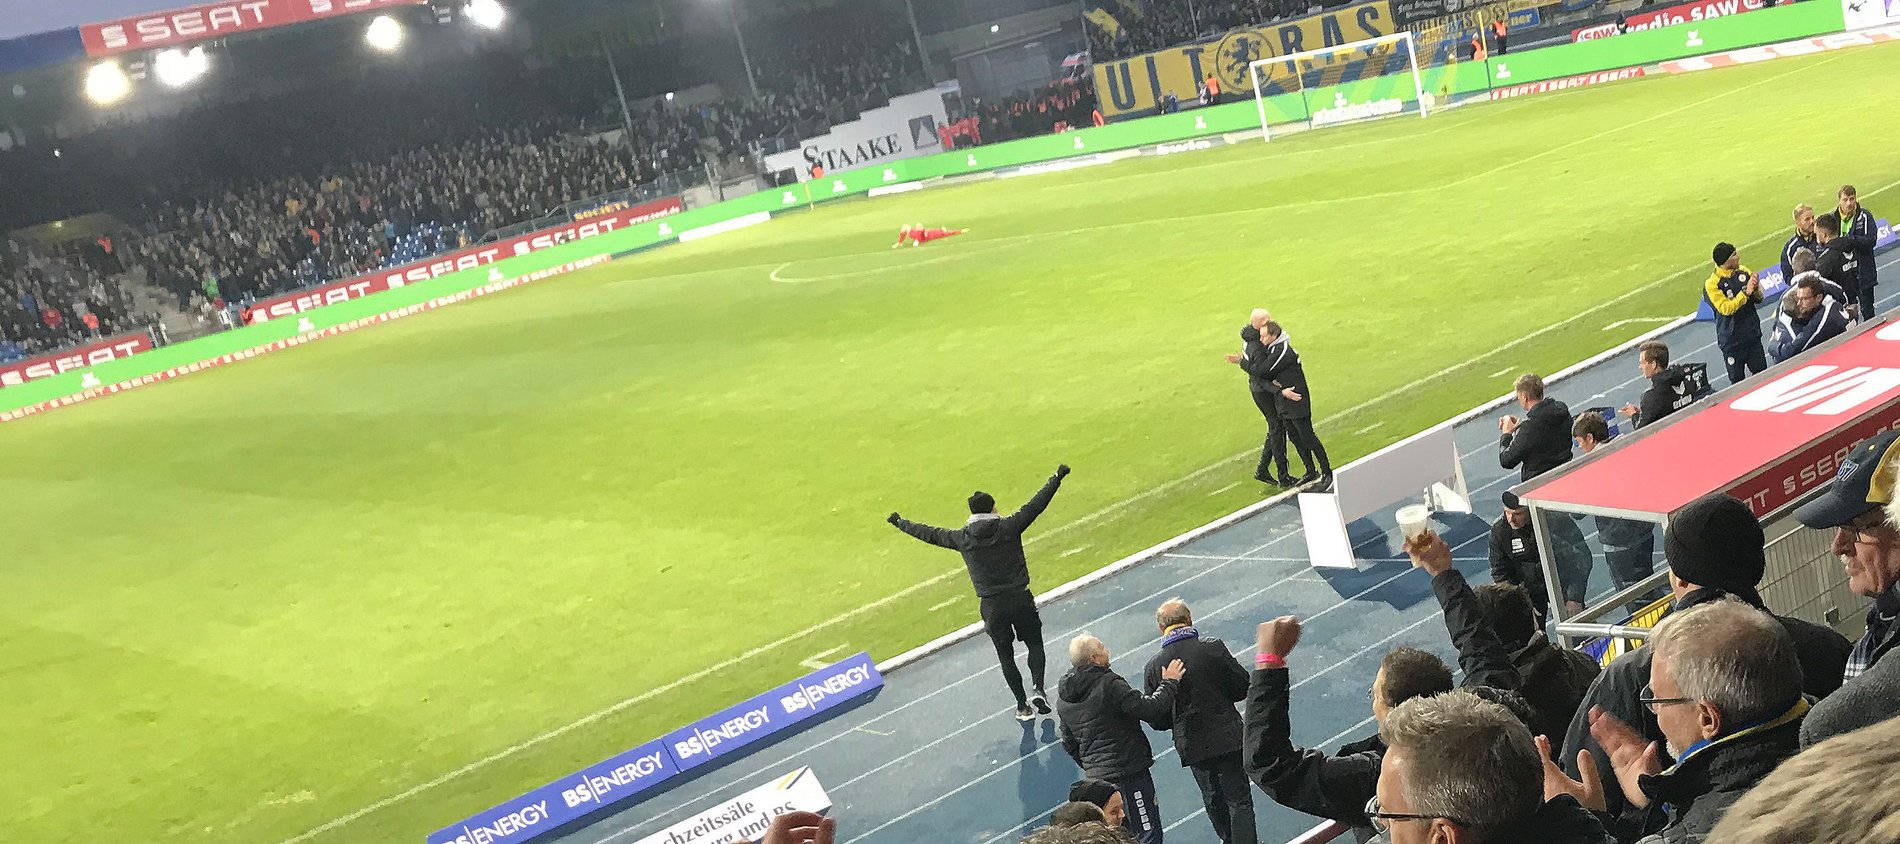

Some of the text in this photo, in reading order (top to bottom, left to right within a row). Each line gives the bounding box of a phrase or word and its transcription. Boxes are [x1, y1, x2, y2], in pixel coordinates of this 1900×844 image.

[136, 3, 270, 42] SEAT
[1690, 0, 1738, 22] SAW
[1599, 68, 1638, 83] SEAT
[803, 133, 902, 175] STAAKE
